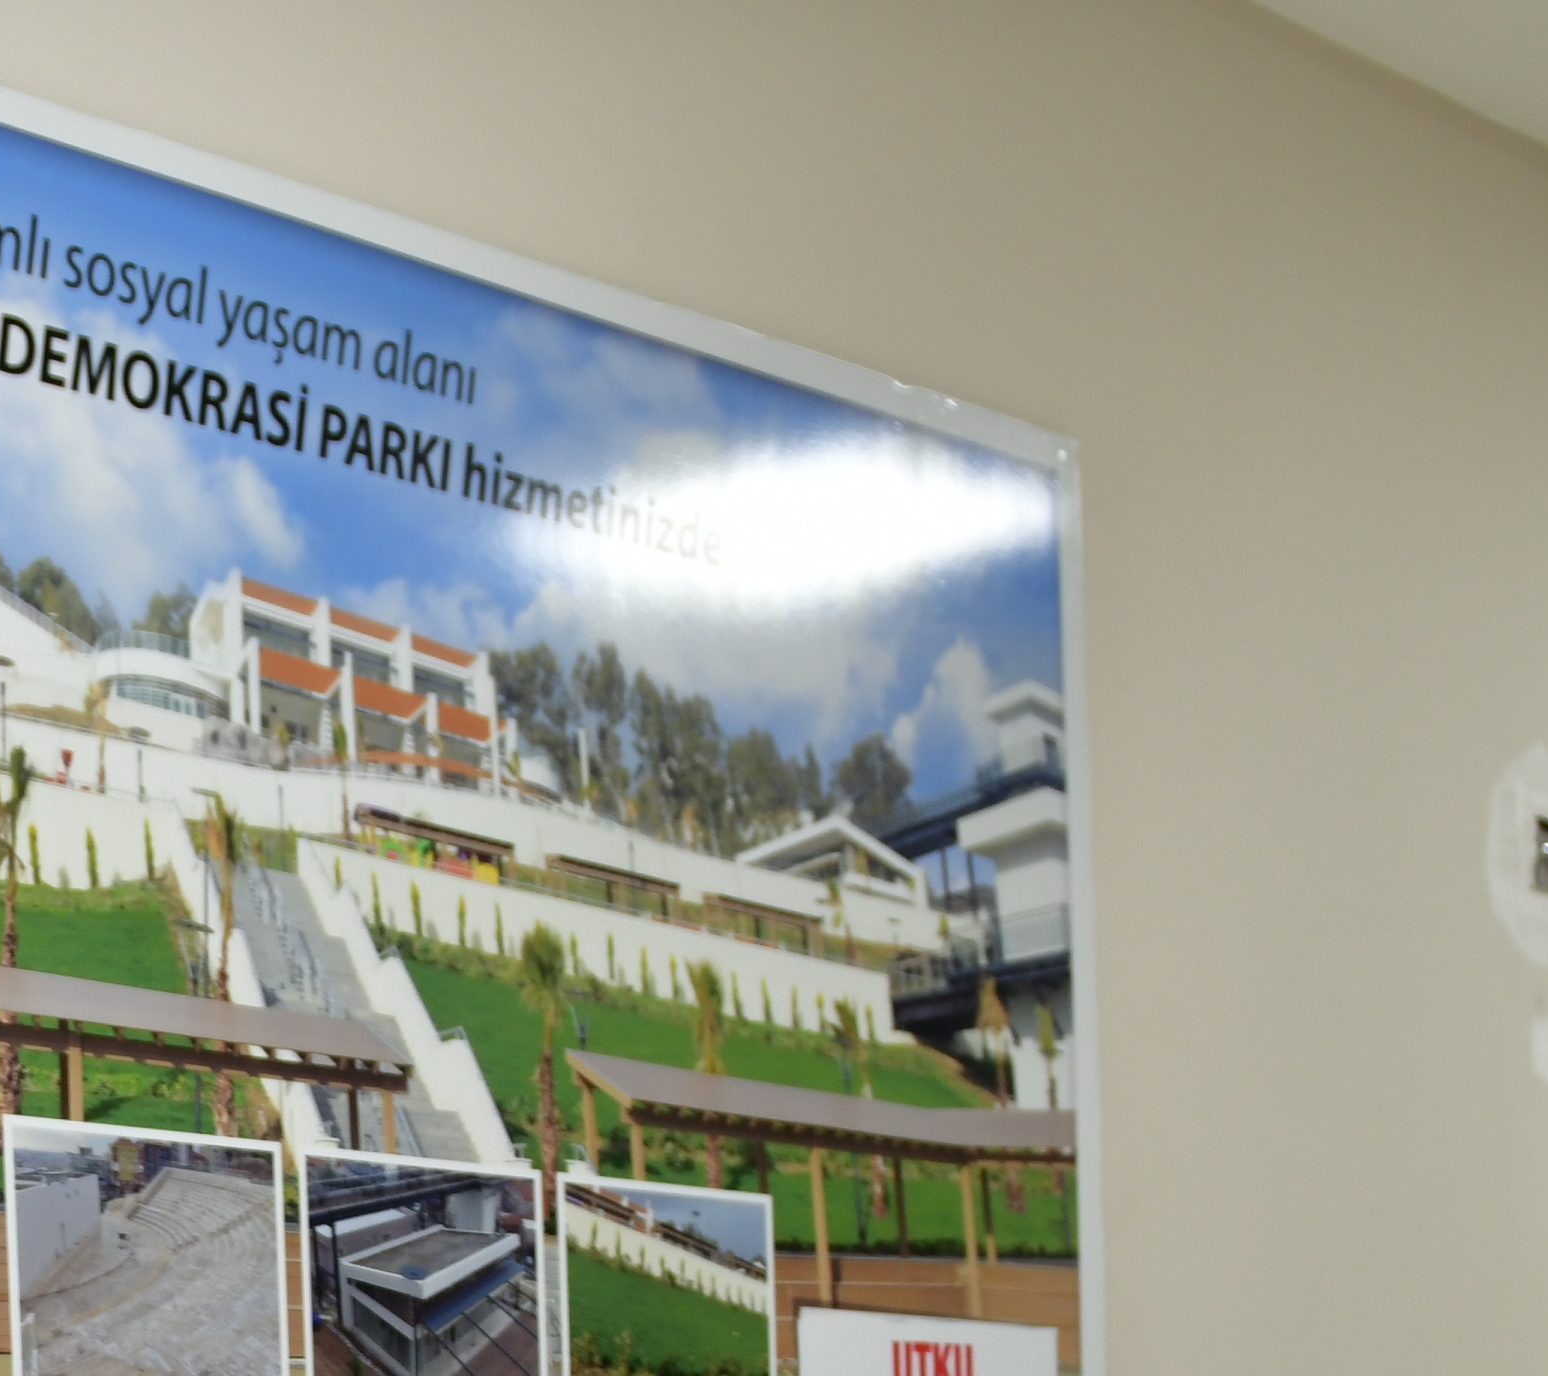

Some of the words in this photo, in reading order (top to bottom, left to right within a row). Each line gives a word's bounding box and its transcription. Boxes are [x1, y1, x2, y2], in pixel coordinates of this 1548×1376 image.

[65, 242, 205, 326] sosyal
[217, 290, 361, 372] yaşam
[373, 330, 476, 405] alanı
[319, 409, 451, 492] PARKI
[463, 442, 724, 567] hizmetinizde
